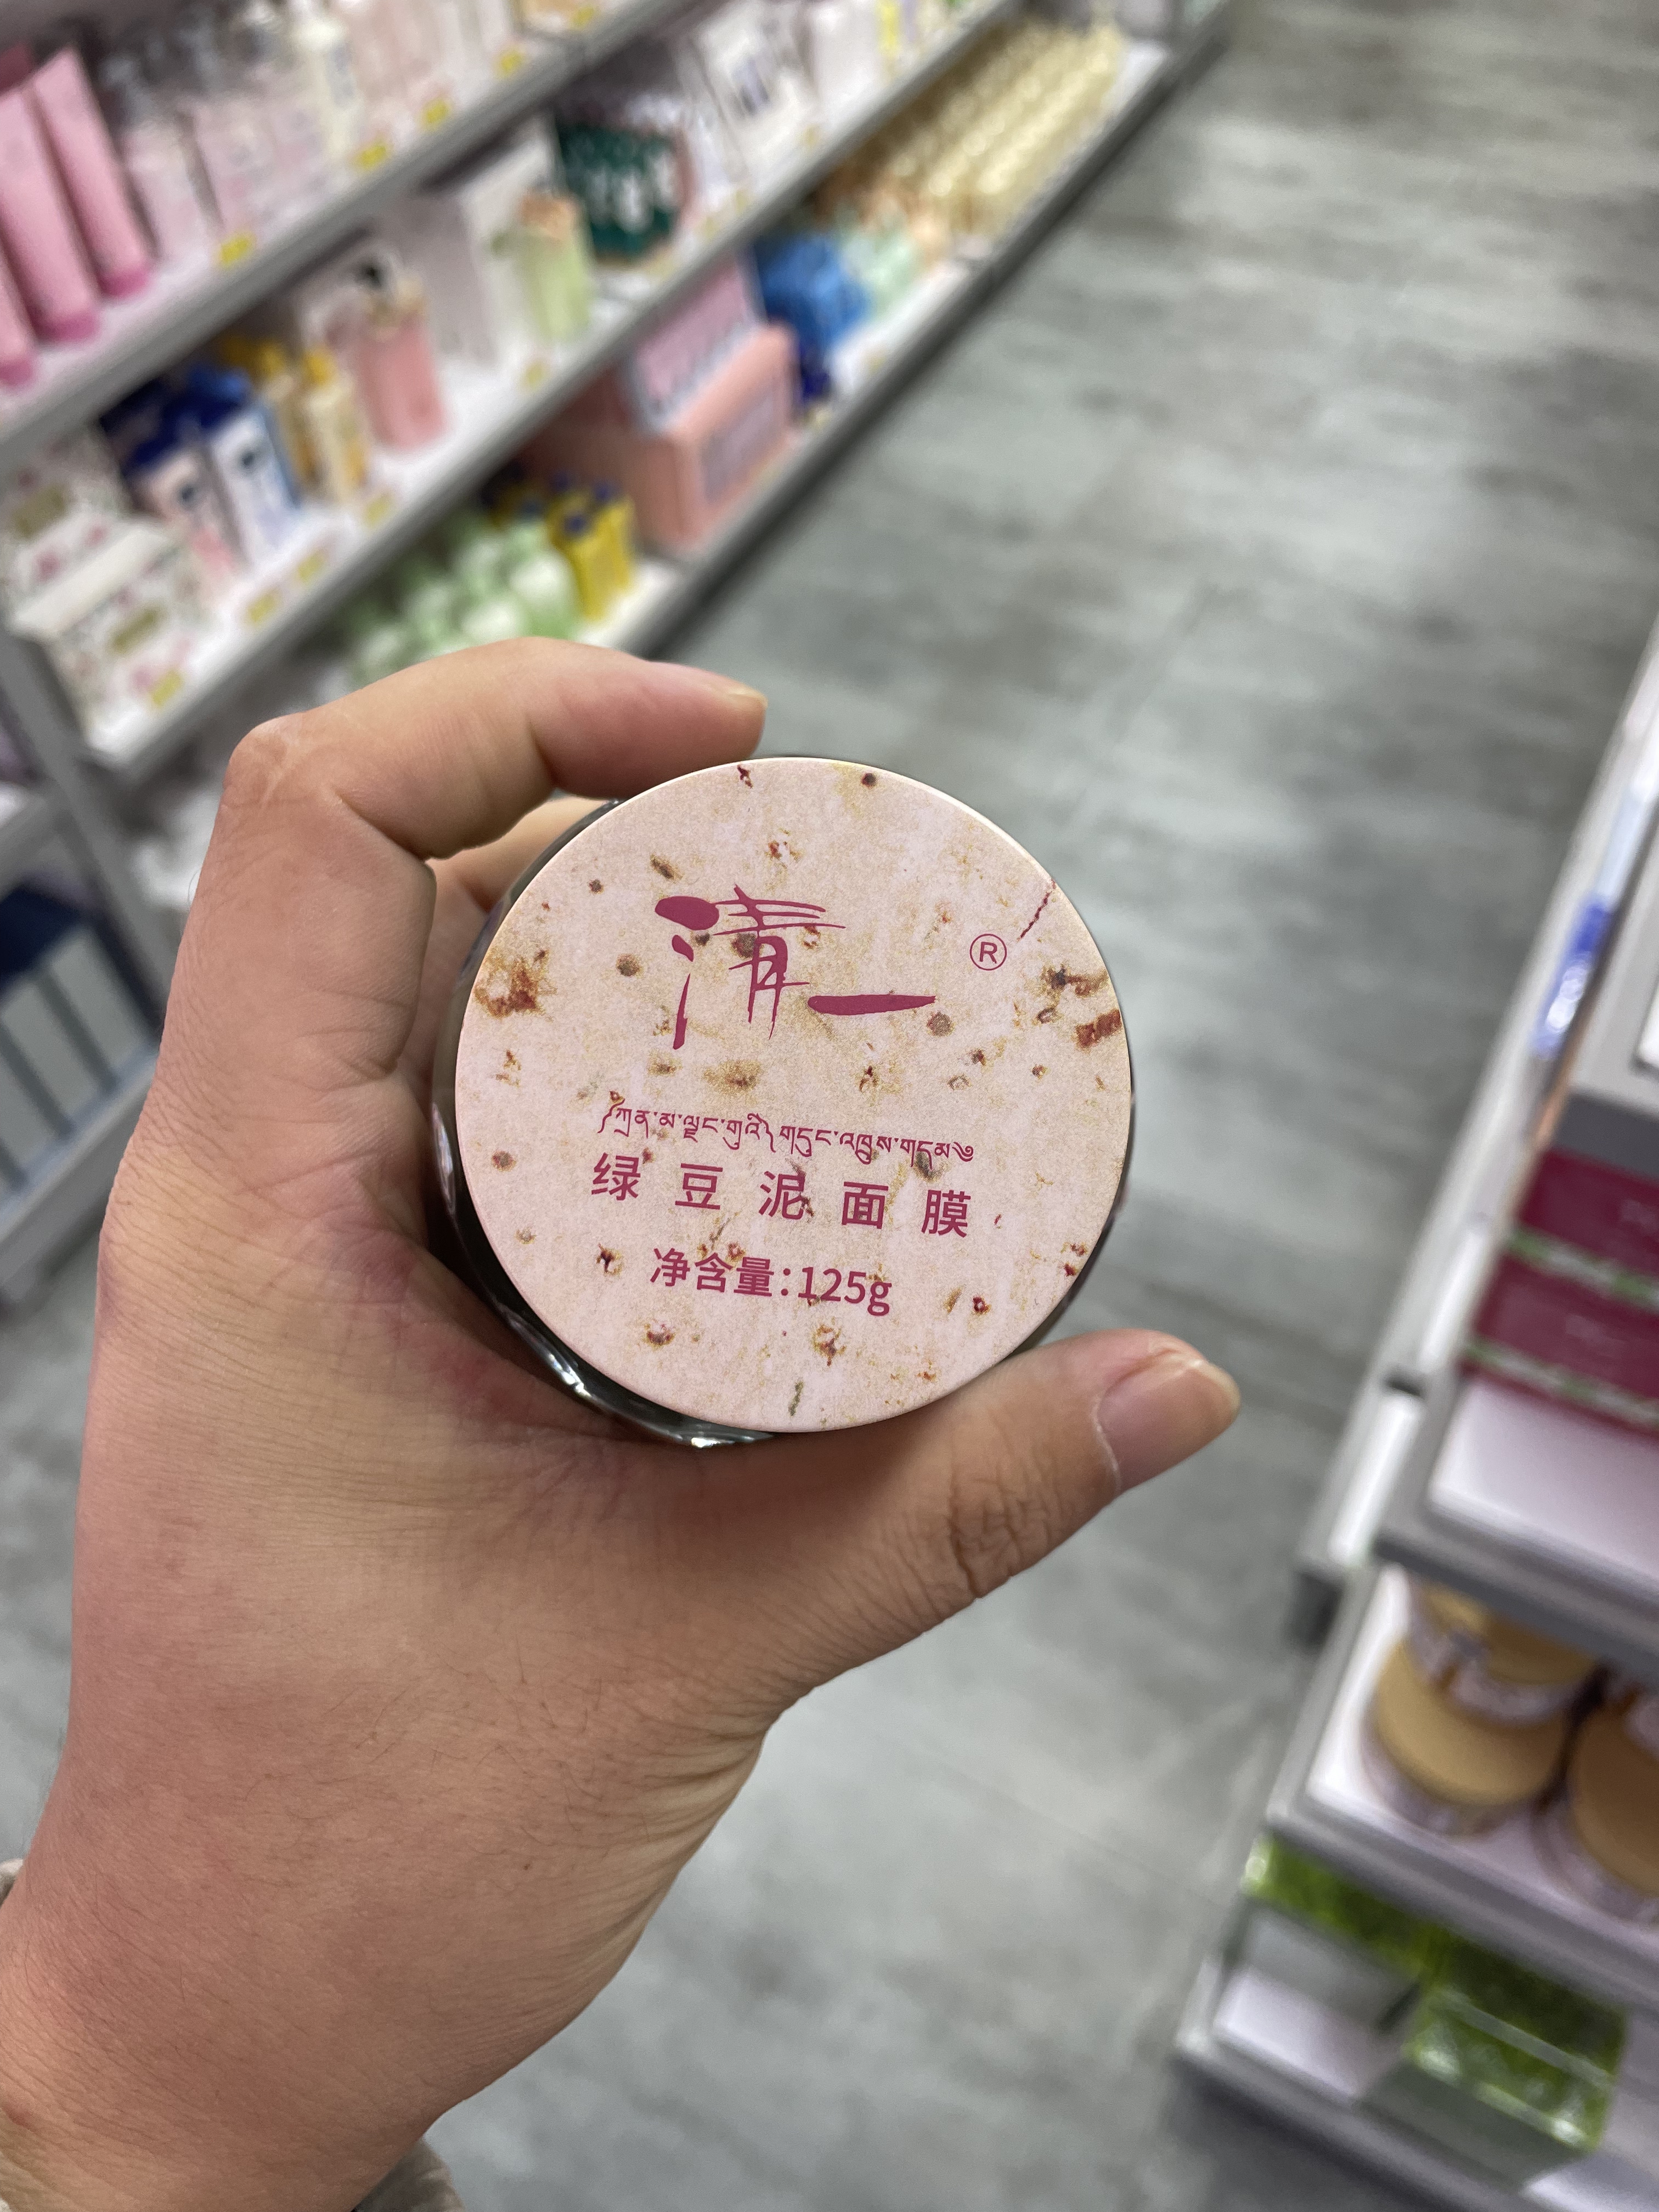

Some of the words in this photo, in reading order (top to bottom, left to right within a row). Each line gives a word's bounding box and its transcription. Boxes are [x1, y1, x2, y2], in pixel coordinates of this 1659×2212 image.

[591, 1153, 972, 1238] 绿豆泥面膜
